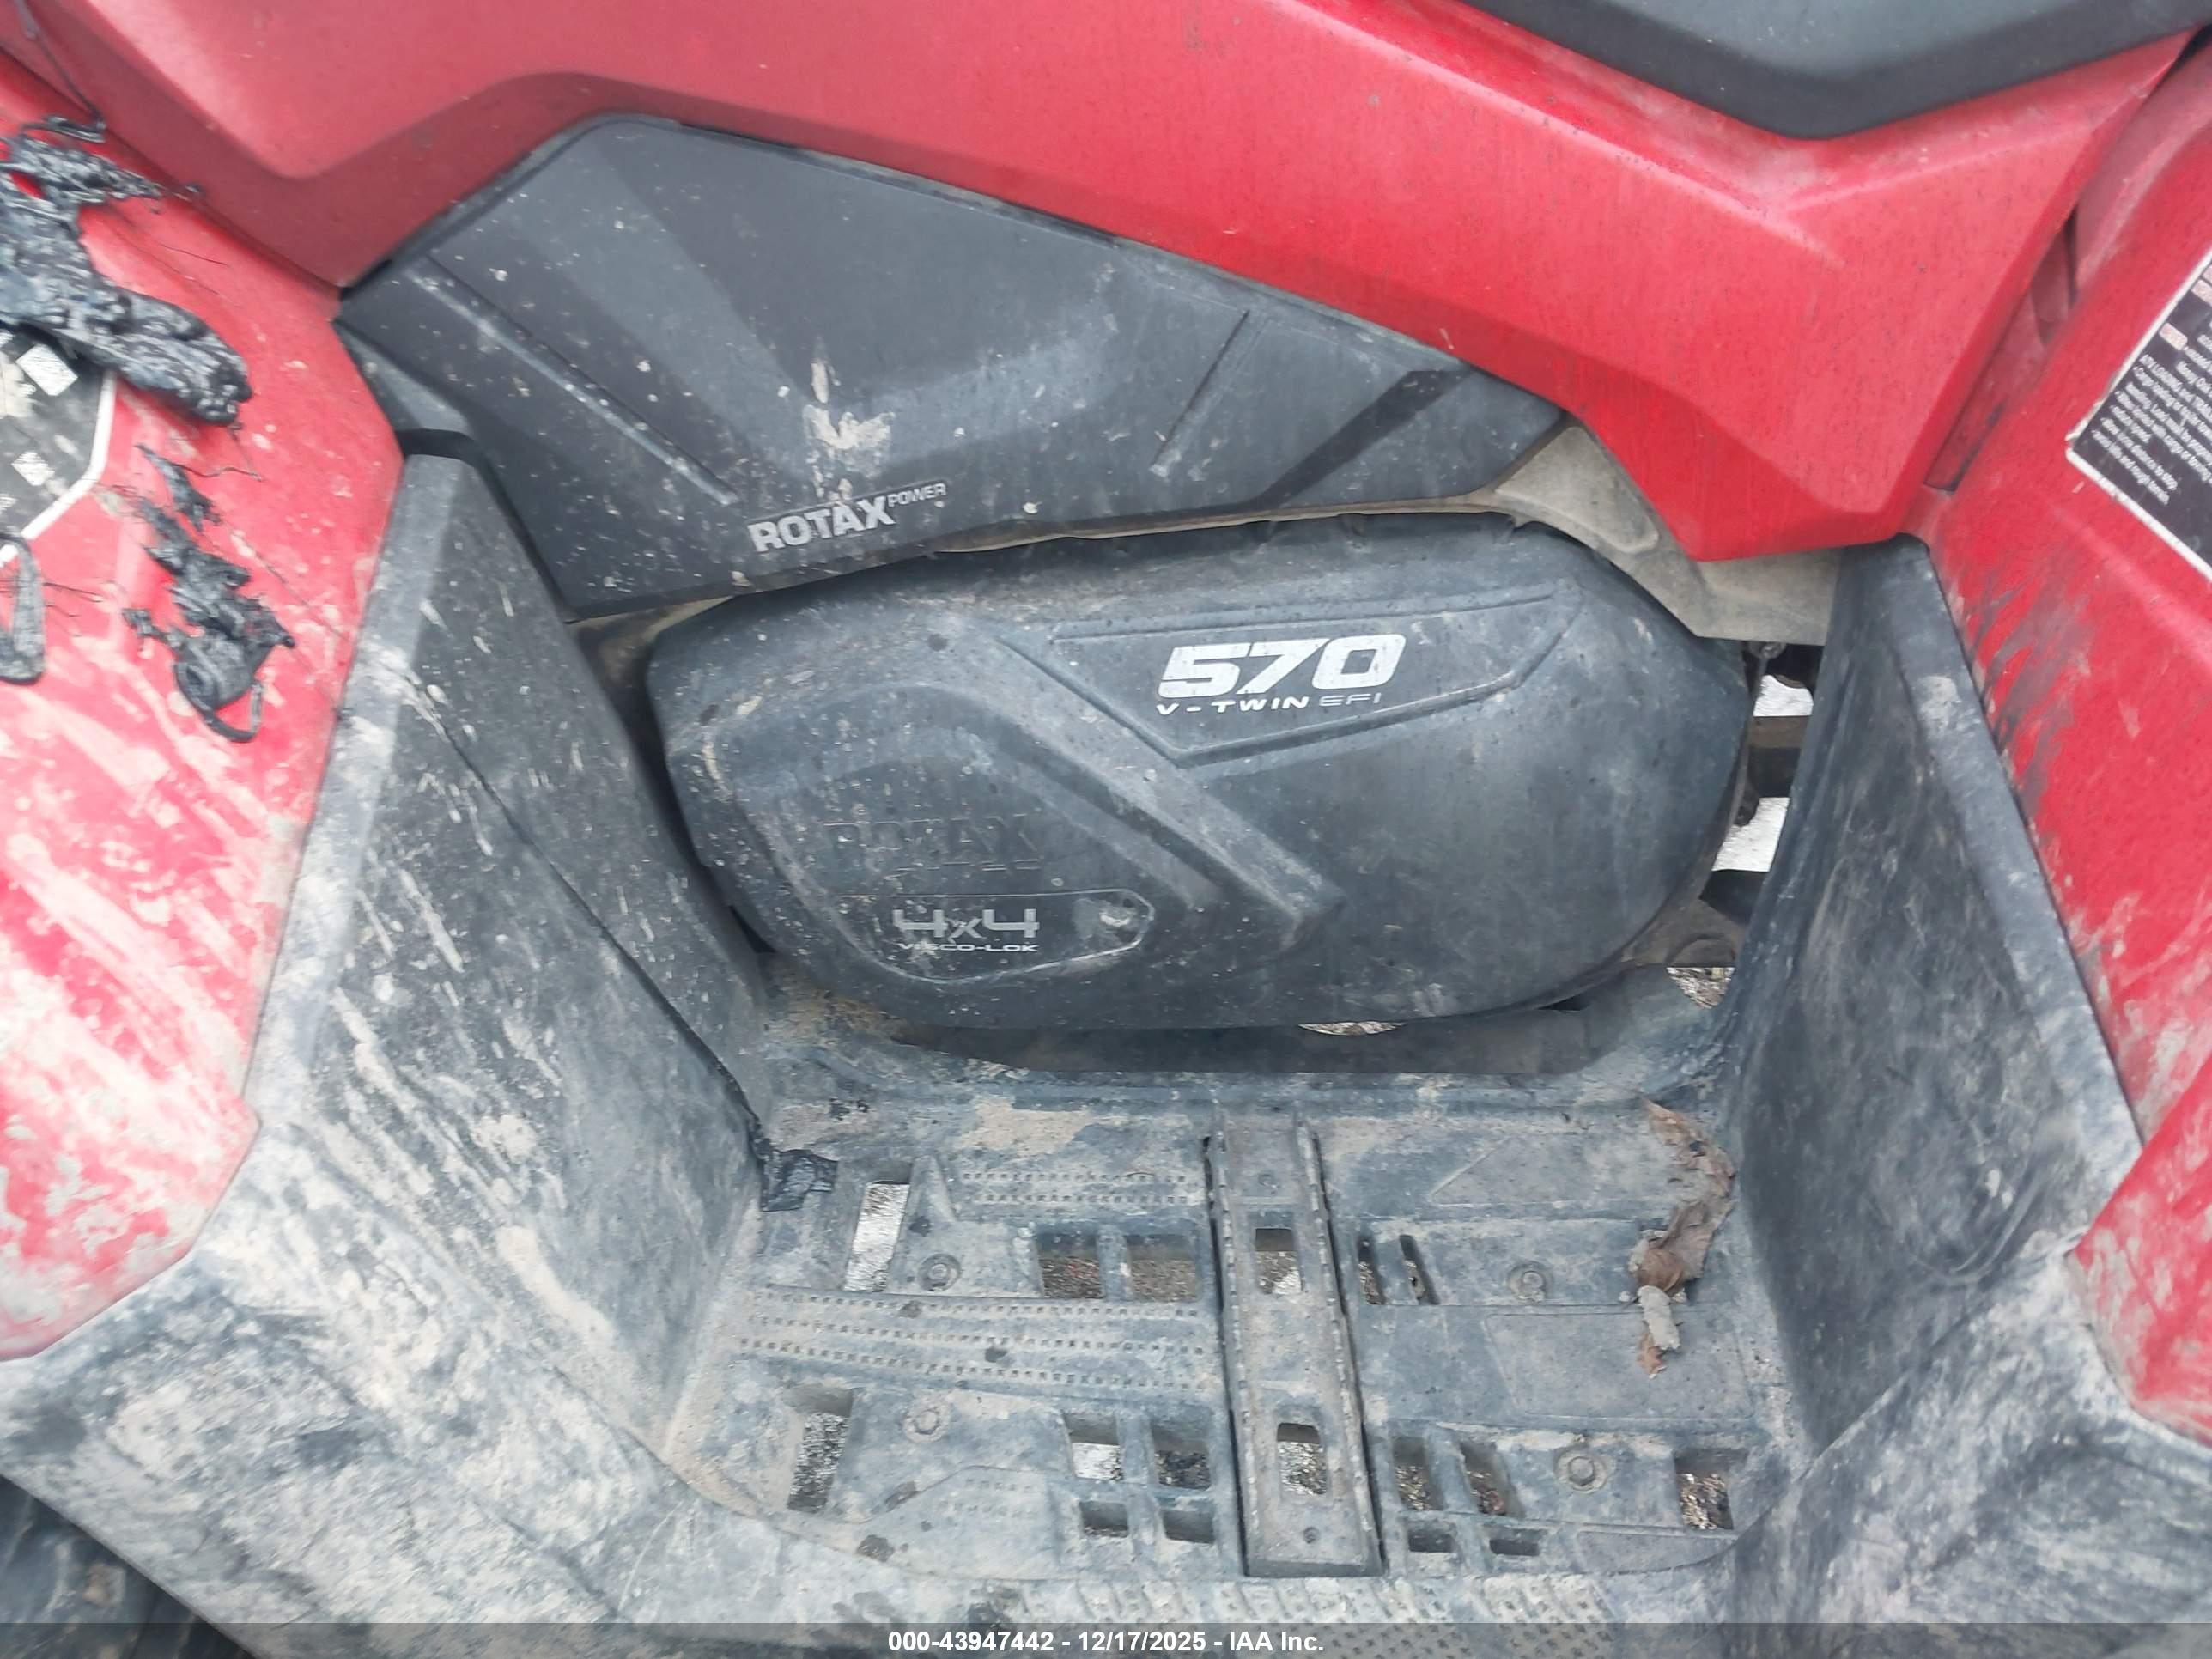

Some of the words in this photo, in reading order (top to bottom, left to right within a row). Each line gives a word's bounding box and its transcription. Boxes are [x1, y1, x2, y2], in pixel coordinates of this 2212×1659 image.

[748, 495, 897, 552] ROTAX
[887, 483, 947, 507] POWER
[1158, 634, 1407, 697] 570
[1319, 692, 1382, 708] EFI
[892, 908, 1040, 944] 4x4
